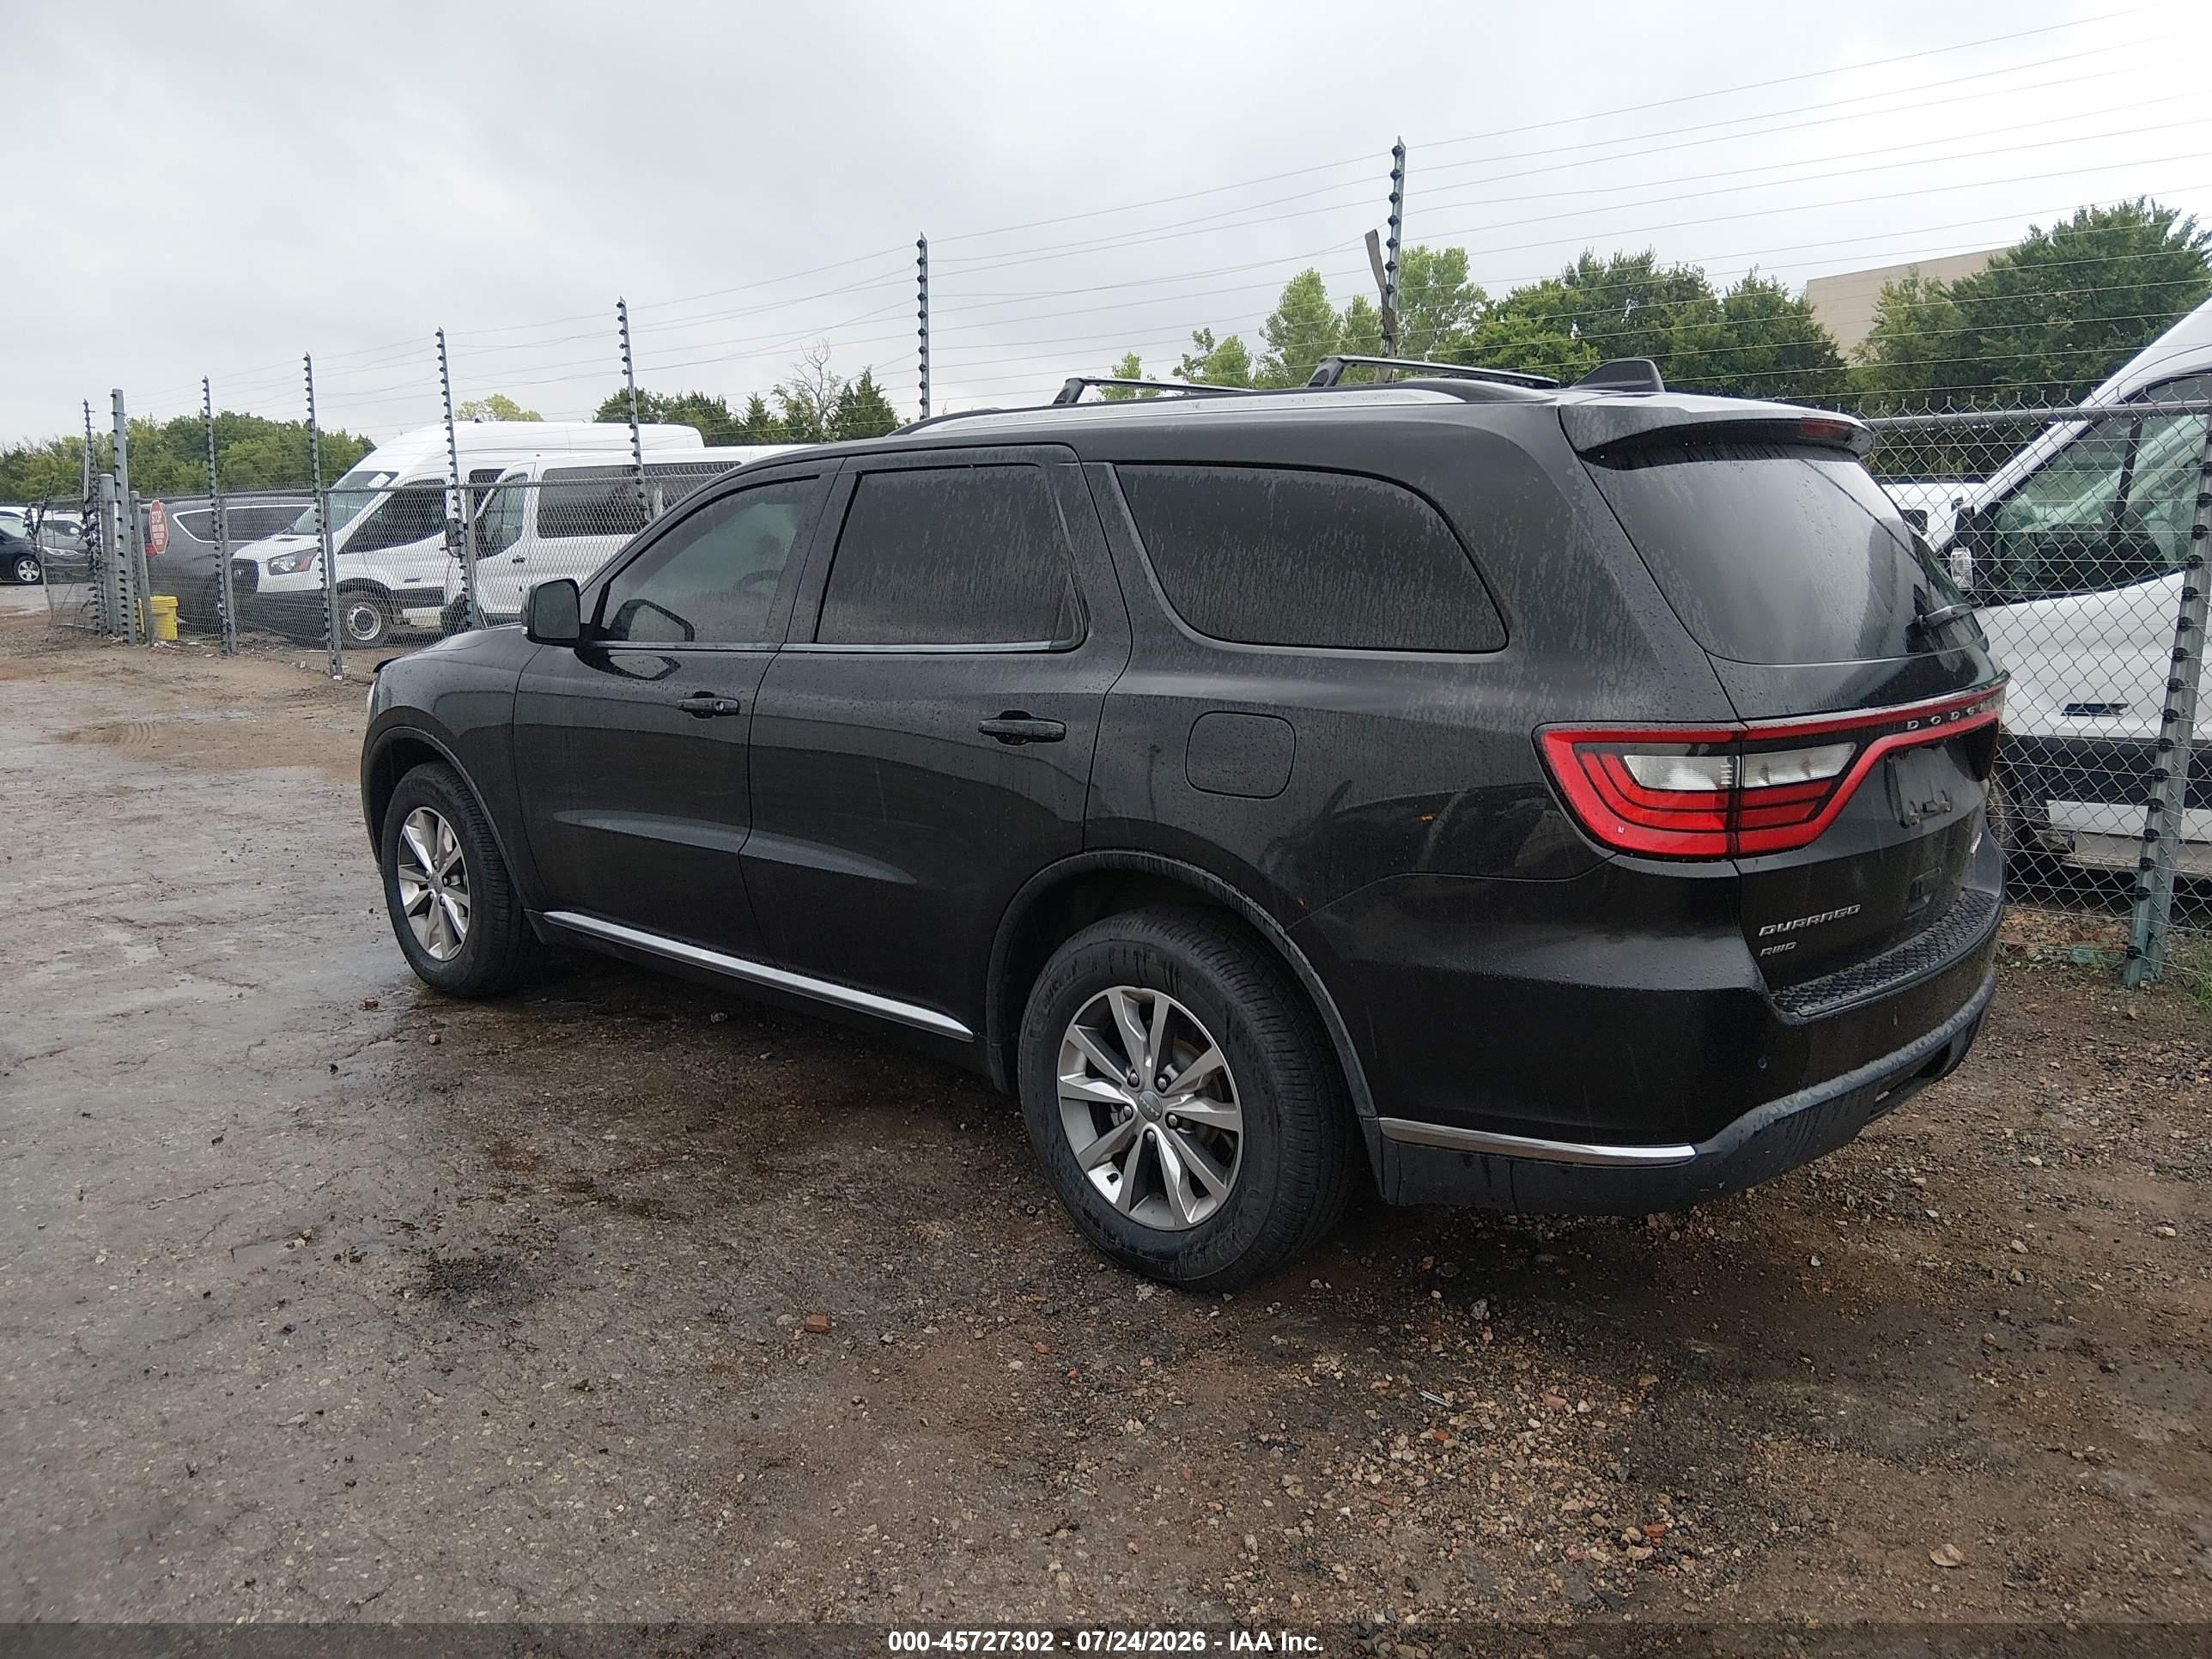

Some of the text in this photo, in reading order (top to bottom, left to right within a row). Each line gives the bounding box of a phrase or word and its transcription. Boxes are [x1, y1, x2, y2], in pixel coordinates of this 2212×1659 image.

[151, 510, 162, 523] STOP
[1758, 903, 1862, 937] DURANGO
[1759, 941, 1797, 957] AWD
